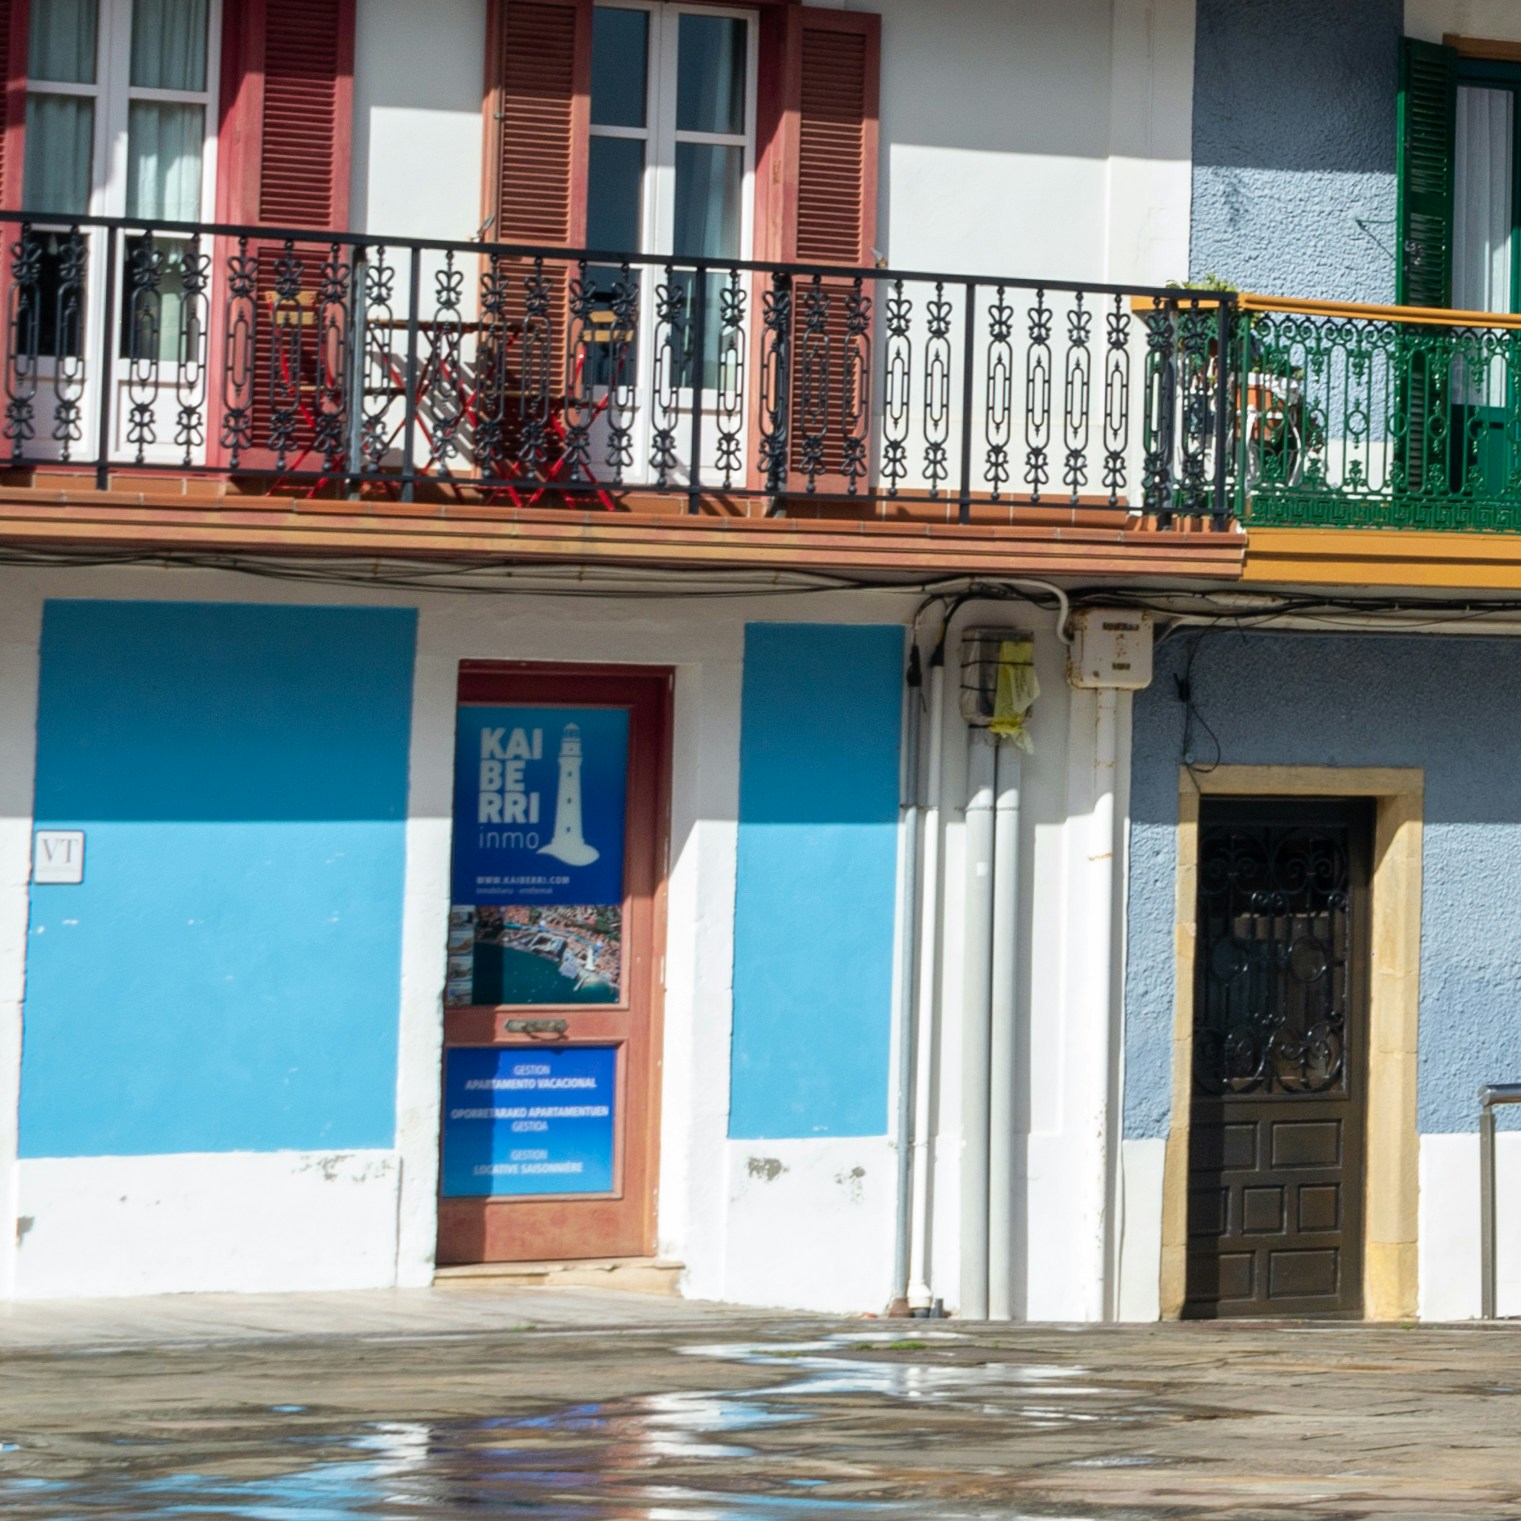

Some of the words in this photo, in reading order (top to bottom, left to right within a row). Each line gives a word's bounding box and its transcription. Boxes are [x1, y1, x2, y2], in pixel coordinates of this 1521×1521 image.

[480, 727, 543, 760] KAI
[479, 759, 526, 792] BE
[478, 792, 540, 824] RRI
[478, 826, 540, 849] inmo
[40, 838, 79, 864] VT
[465, 1079, 536, 1090] APARTAMENTO
[537, 1078, 597, 1089] VACACIONAL
[528, 1106, 609, 1118] APARTAMENTUEN
